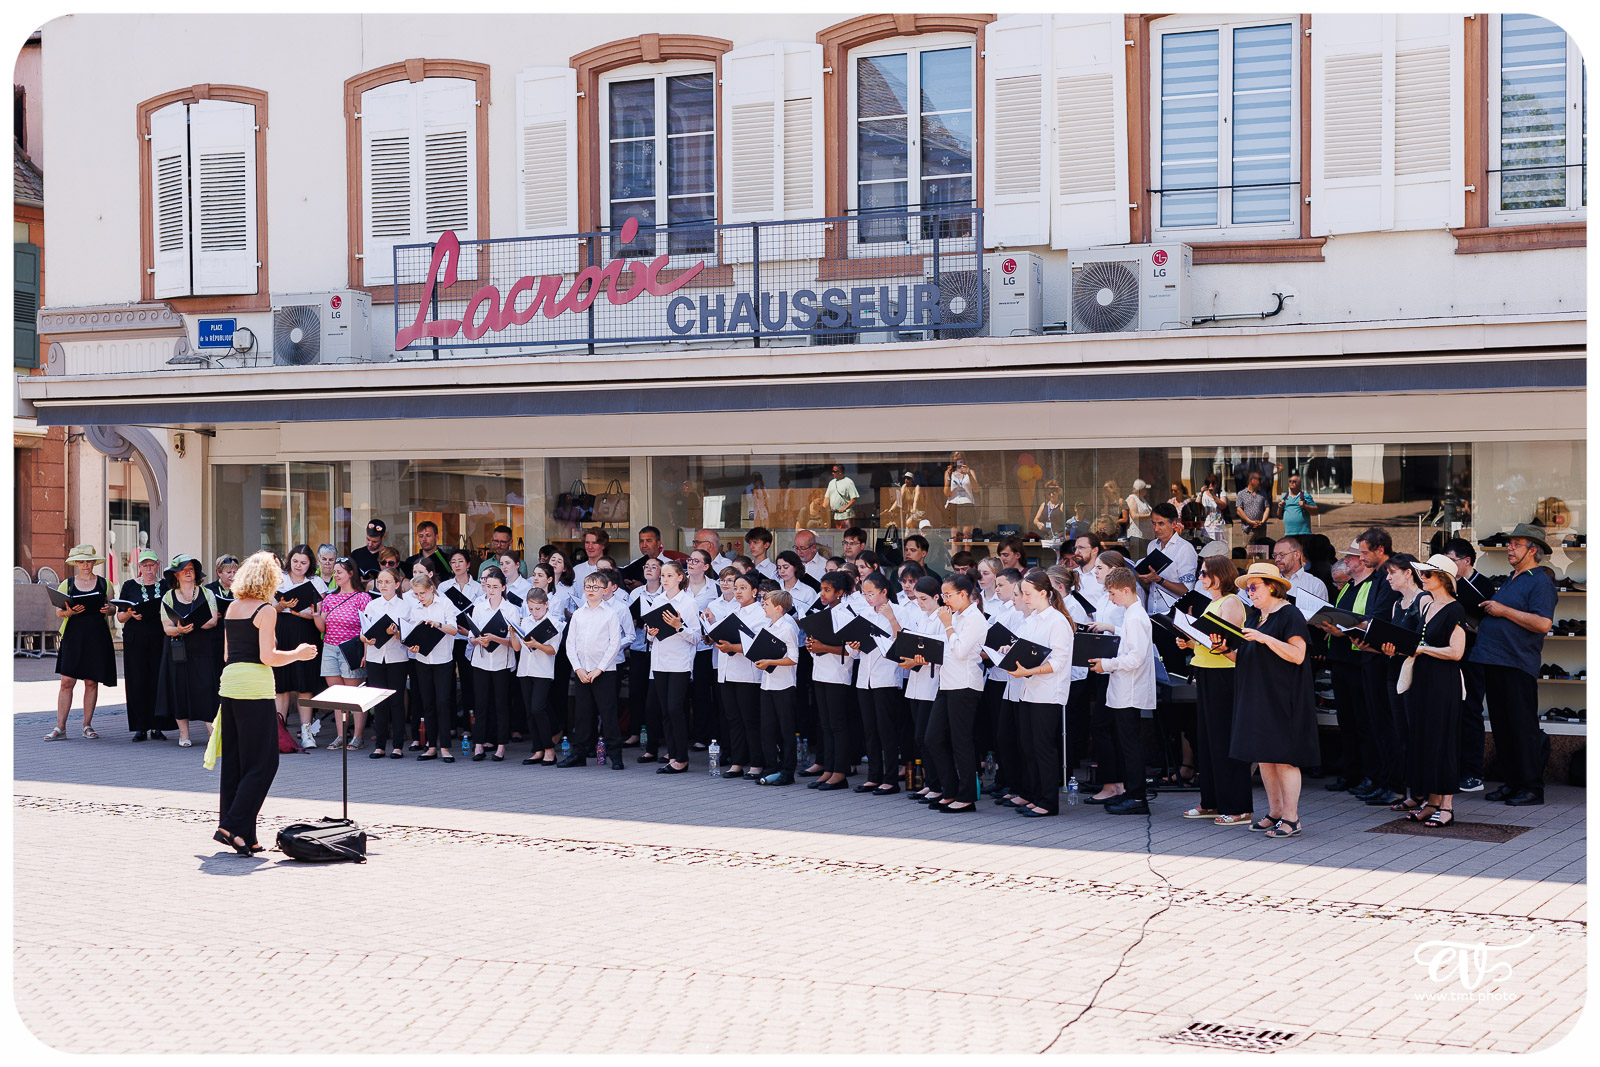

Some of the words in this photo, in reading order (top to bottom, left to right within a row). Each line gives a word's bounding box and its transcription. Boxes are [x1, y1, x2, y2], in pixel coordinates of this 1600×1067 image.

[1153, 268, 1166, 278] LG
[395, 217, 704, 350] Lacroix
[1003, 276, 1016, 286] LG
[666, 284, 941, 334] CHAUSSEUR
[331, 311, 341, 319] LG
[210, 333, 233, 342] RÉPUBLIQU
